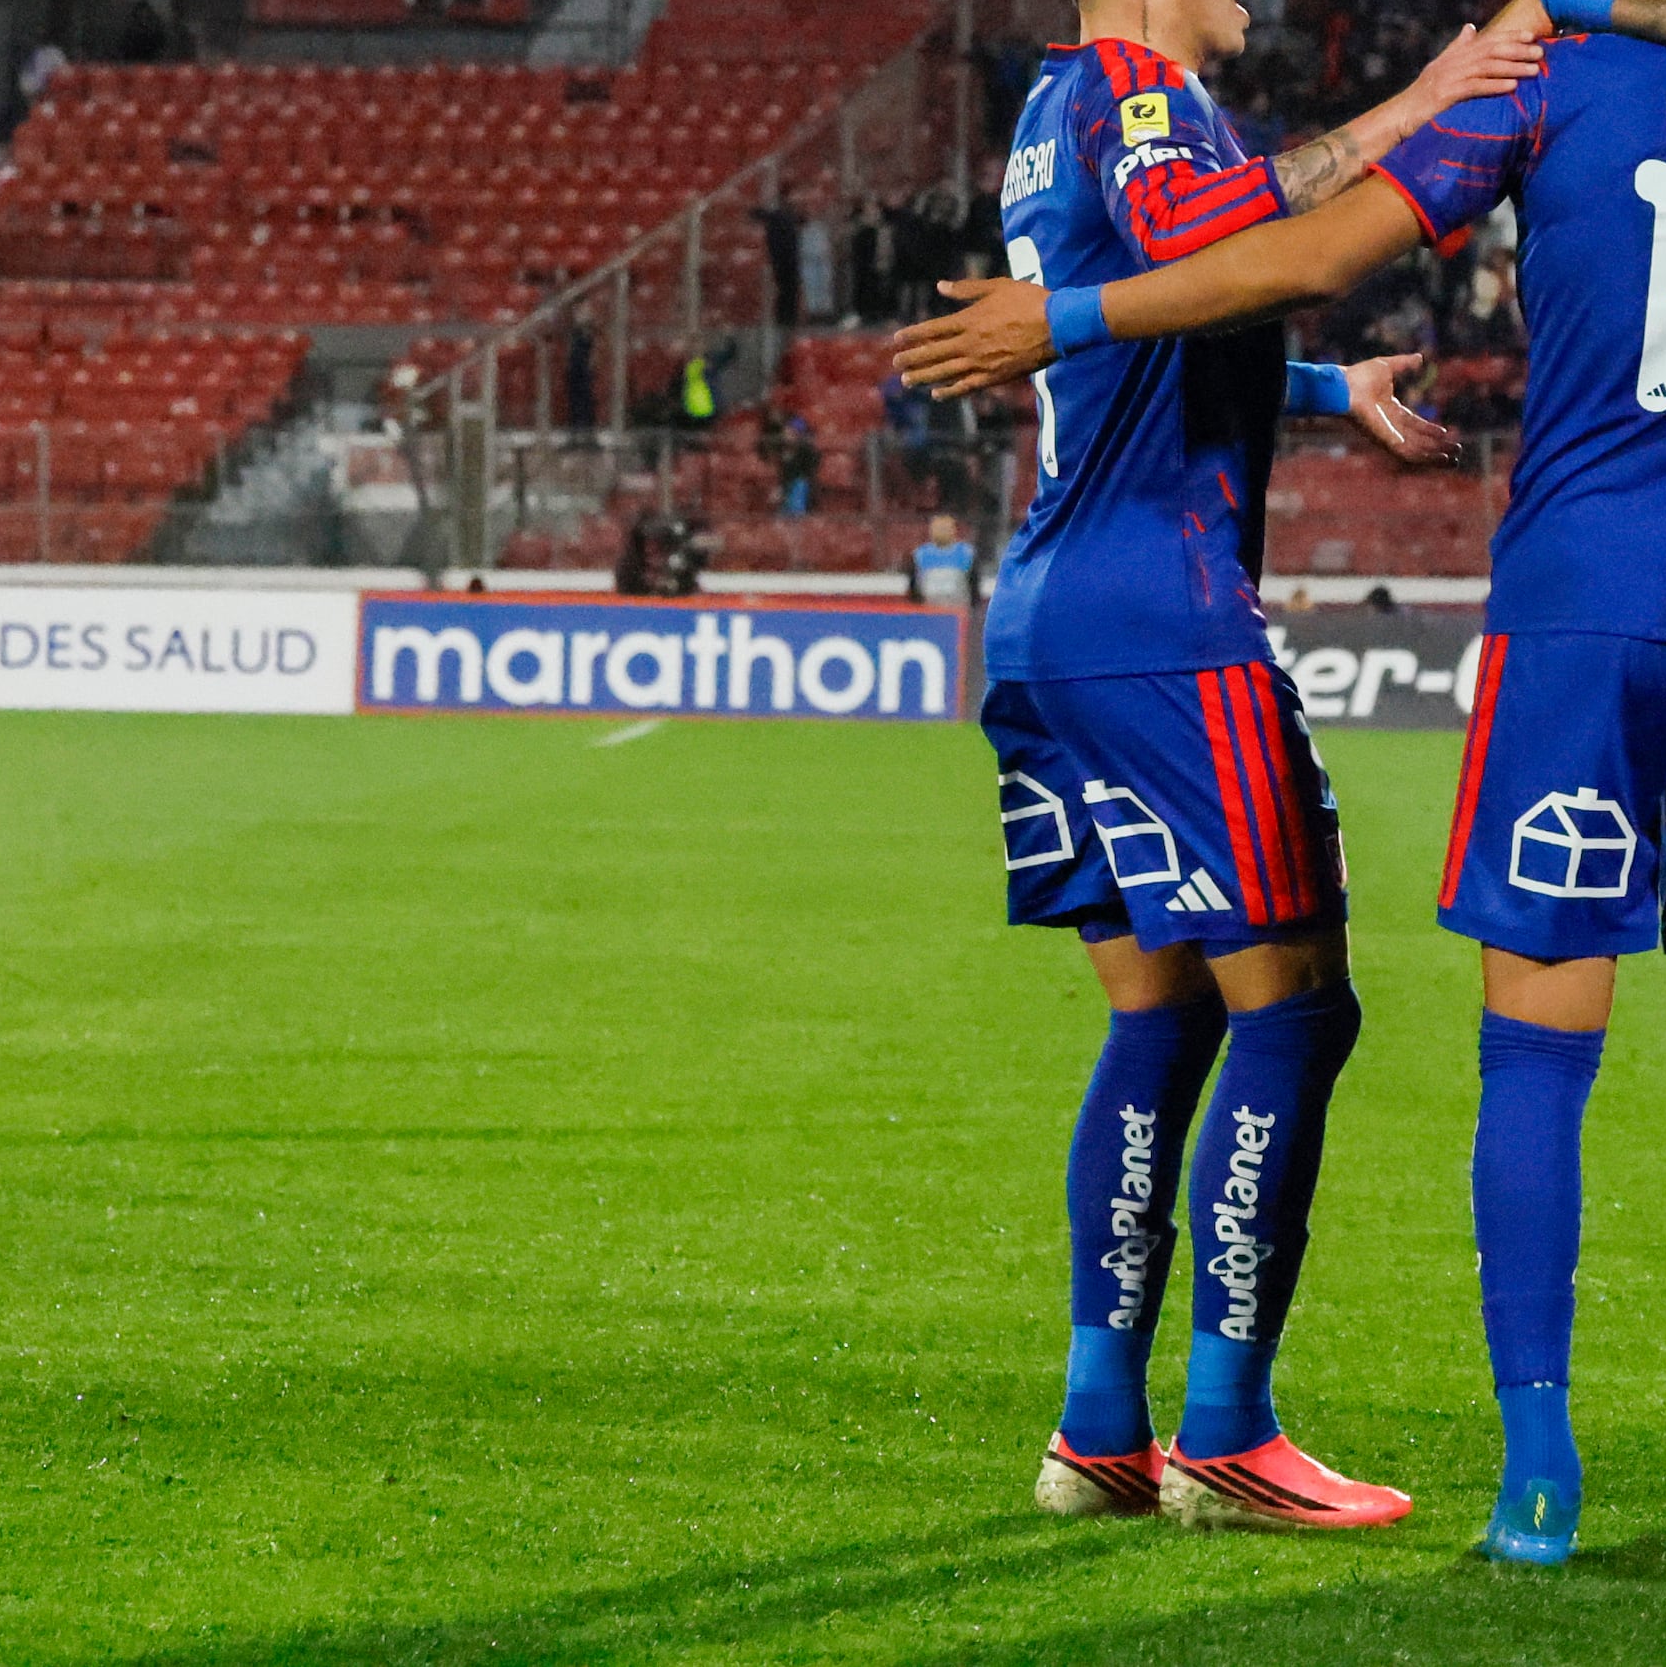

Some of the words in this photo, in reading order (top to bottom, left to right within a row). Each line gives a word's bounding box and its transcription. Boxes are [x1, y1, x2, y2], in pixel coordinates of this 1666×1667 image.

[124, 623, 317, 677] SALUD
[372, 613, 945, 714] marathon
[1100, 1103, 1161, 1331] AutoPlanet
[1207, 1104, 1276, 1343] AutoPlanet
